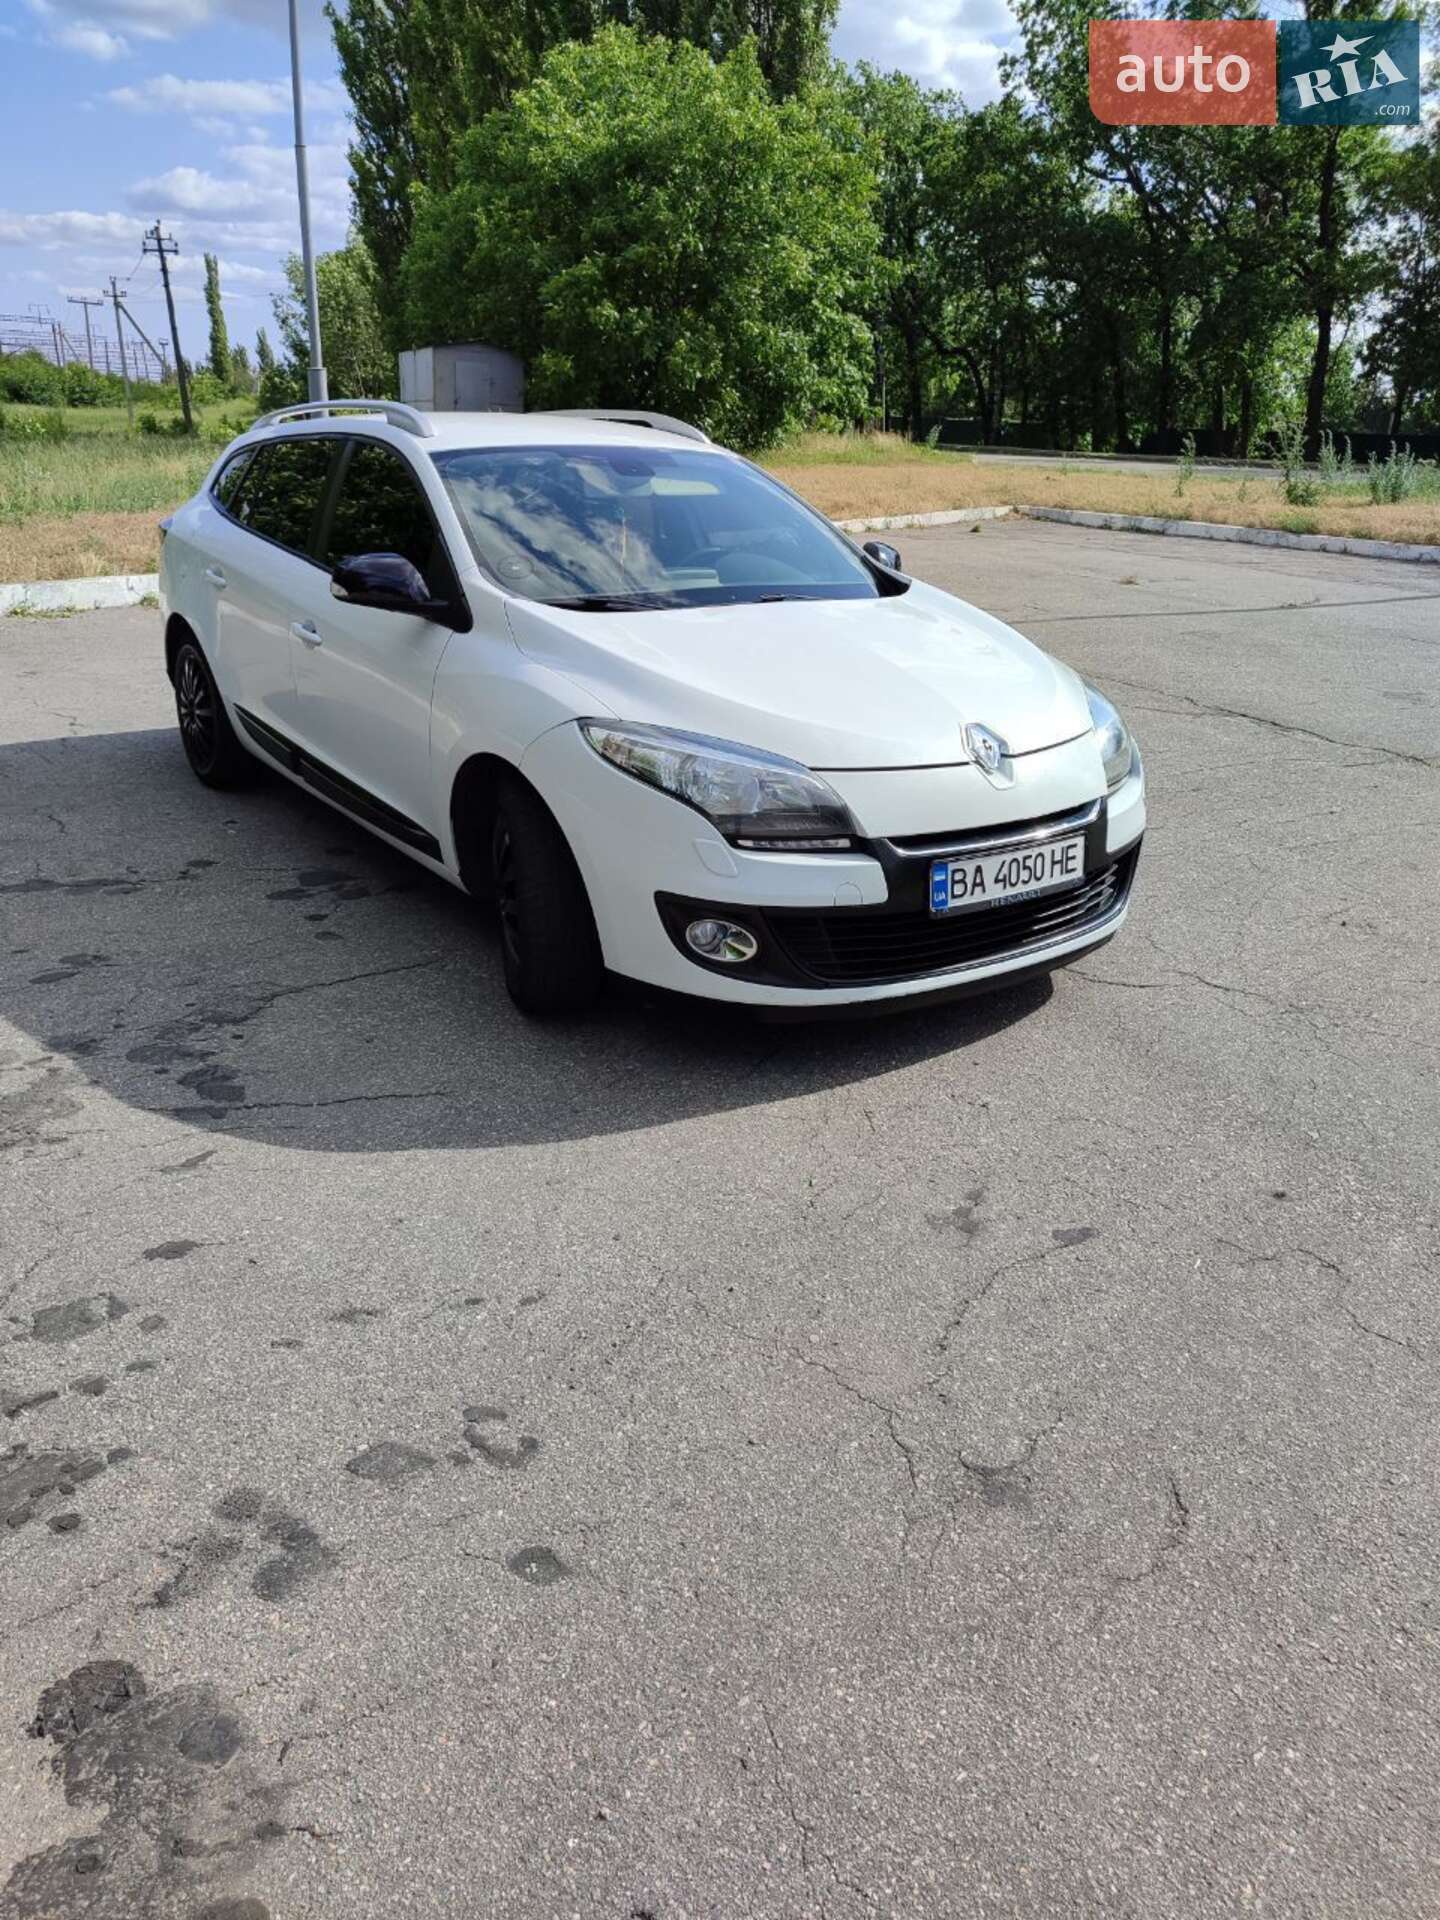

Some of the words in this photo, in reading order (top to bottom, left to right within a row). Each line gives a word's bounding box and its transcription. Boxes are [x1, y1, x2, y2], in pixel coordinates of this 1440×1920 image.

[951, 865, 986, 899] BA
[994, 852, 1045, 890] 4050
[1050, 843, 1078, 878] HE
